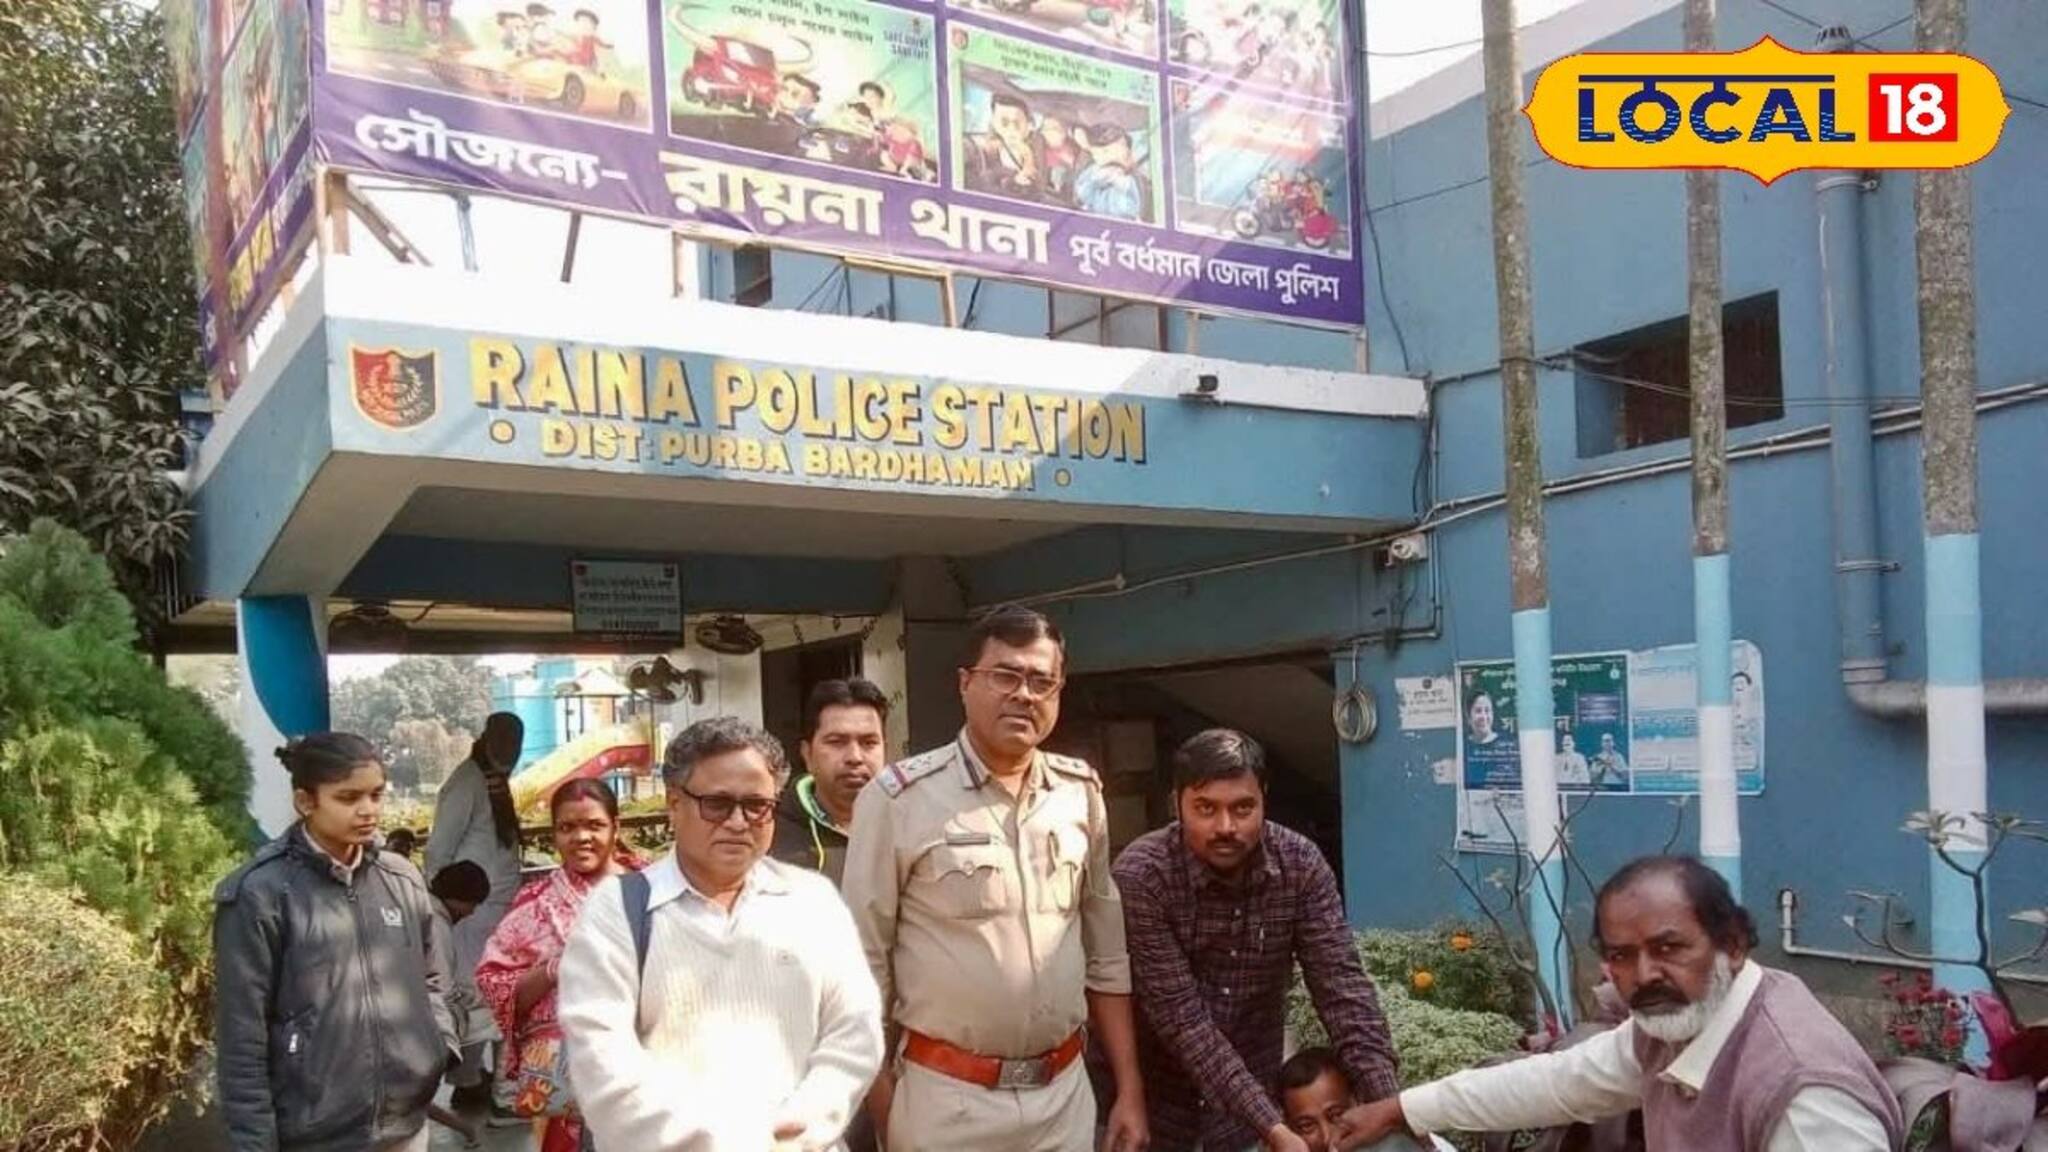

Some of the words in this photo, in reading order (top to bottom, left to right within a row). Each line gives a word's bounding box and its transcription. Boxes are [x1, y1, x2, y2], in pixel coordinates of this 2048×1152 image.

[658, 150, 884, 236] রায়না
[909, 199, 1052, 264] থানা
[1069, 230, 1112, 278] পূর্ব
[1117, 238, 1200, 281] বর্ধমান
[1207, 257, 1270, 291] জেলা
[1275, 263, 1340, 304] পুলিশ
[470, 336, 701, 427] RAINA
[714, 360, 924, 446] POLICE
[931, 384, 1148, 465] STATION
[660, 430, 794, 475] PURBA
[803, 443, 1036, 492] BARDHAMAN
